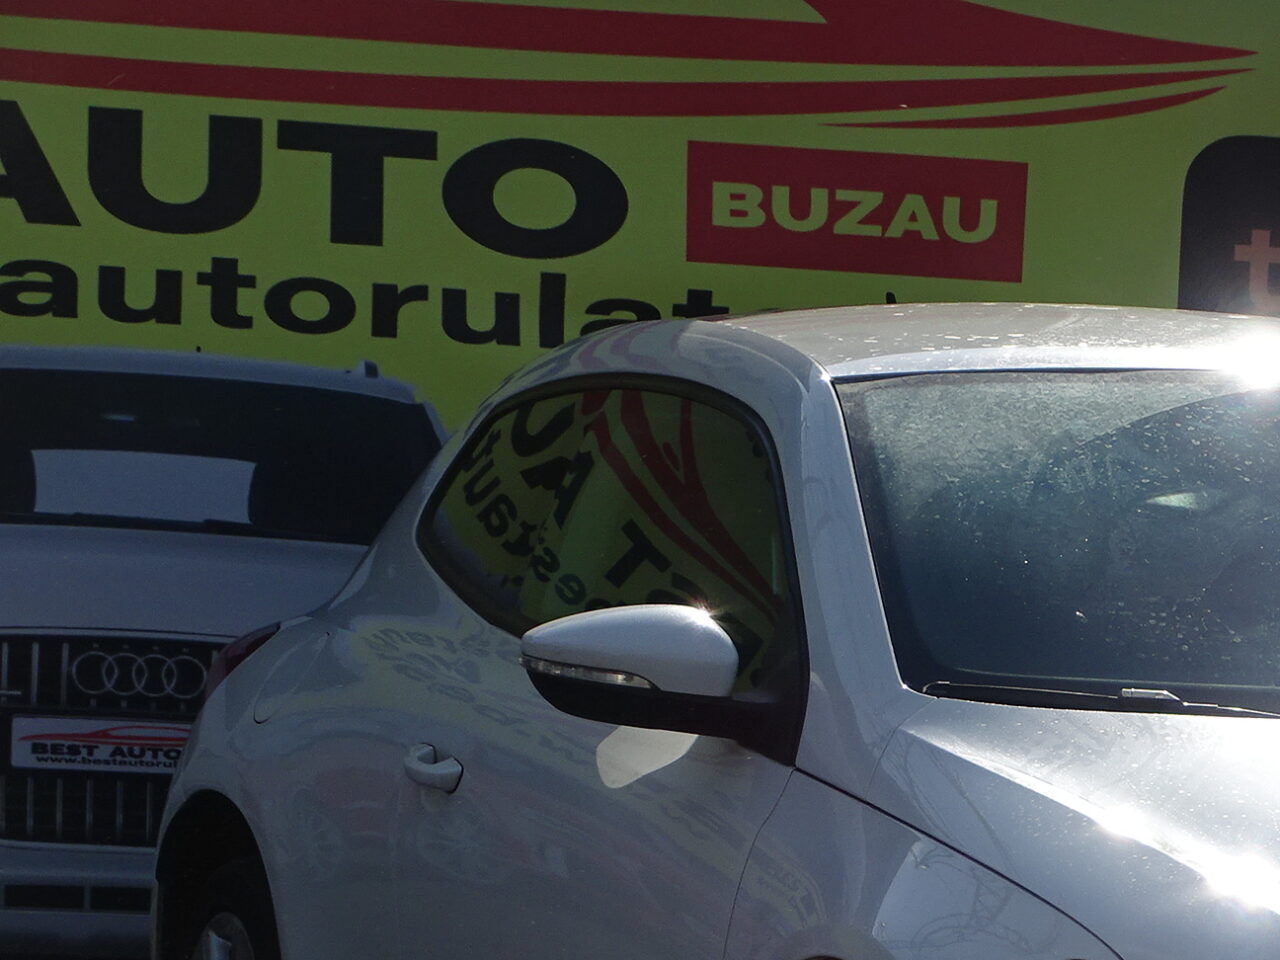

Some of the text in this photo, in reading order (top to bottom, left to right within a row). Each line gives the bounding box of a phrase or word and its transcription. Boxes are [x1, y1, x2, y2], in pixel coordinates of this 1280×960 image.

[711, 181, 998, 244] BUZAU
[31, 742, 182, 760] BEST AUTO
